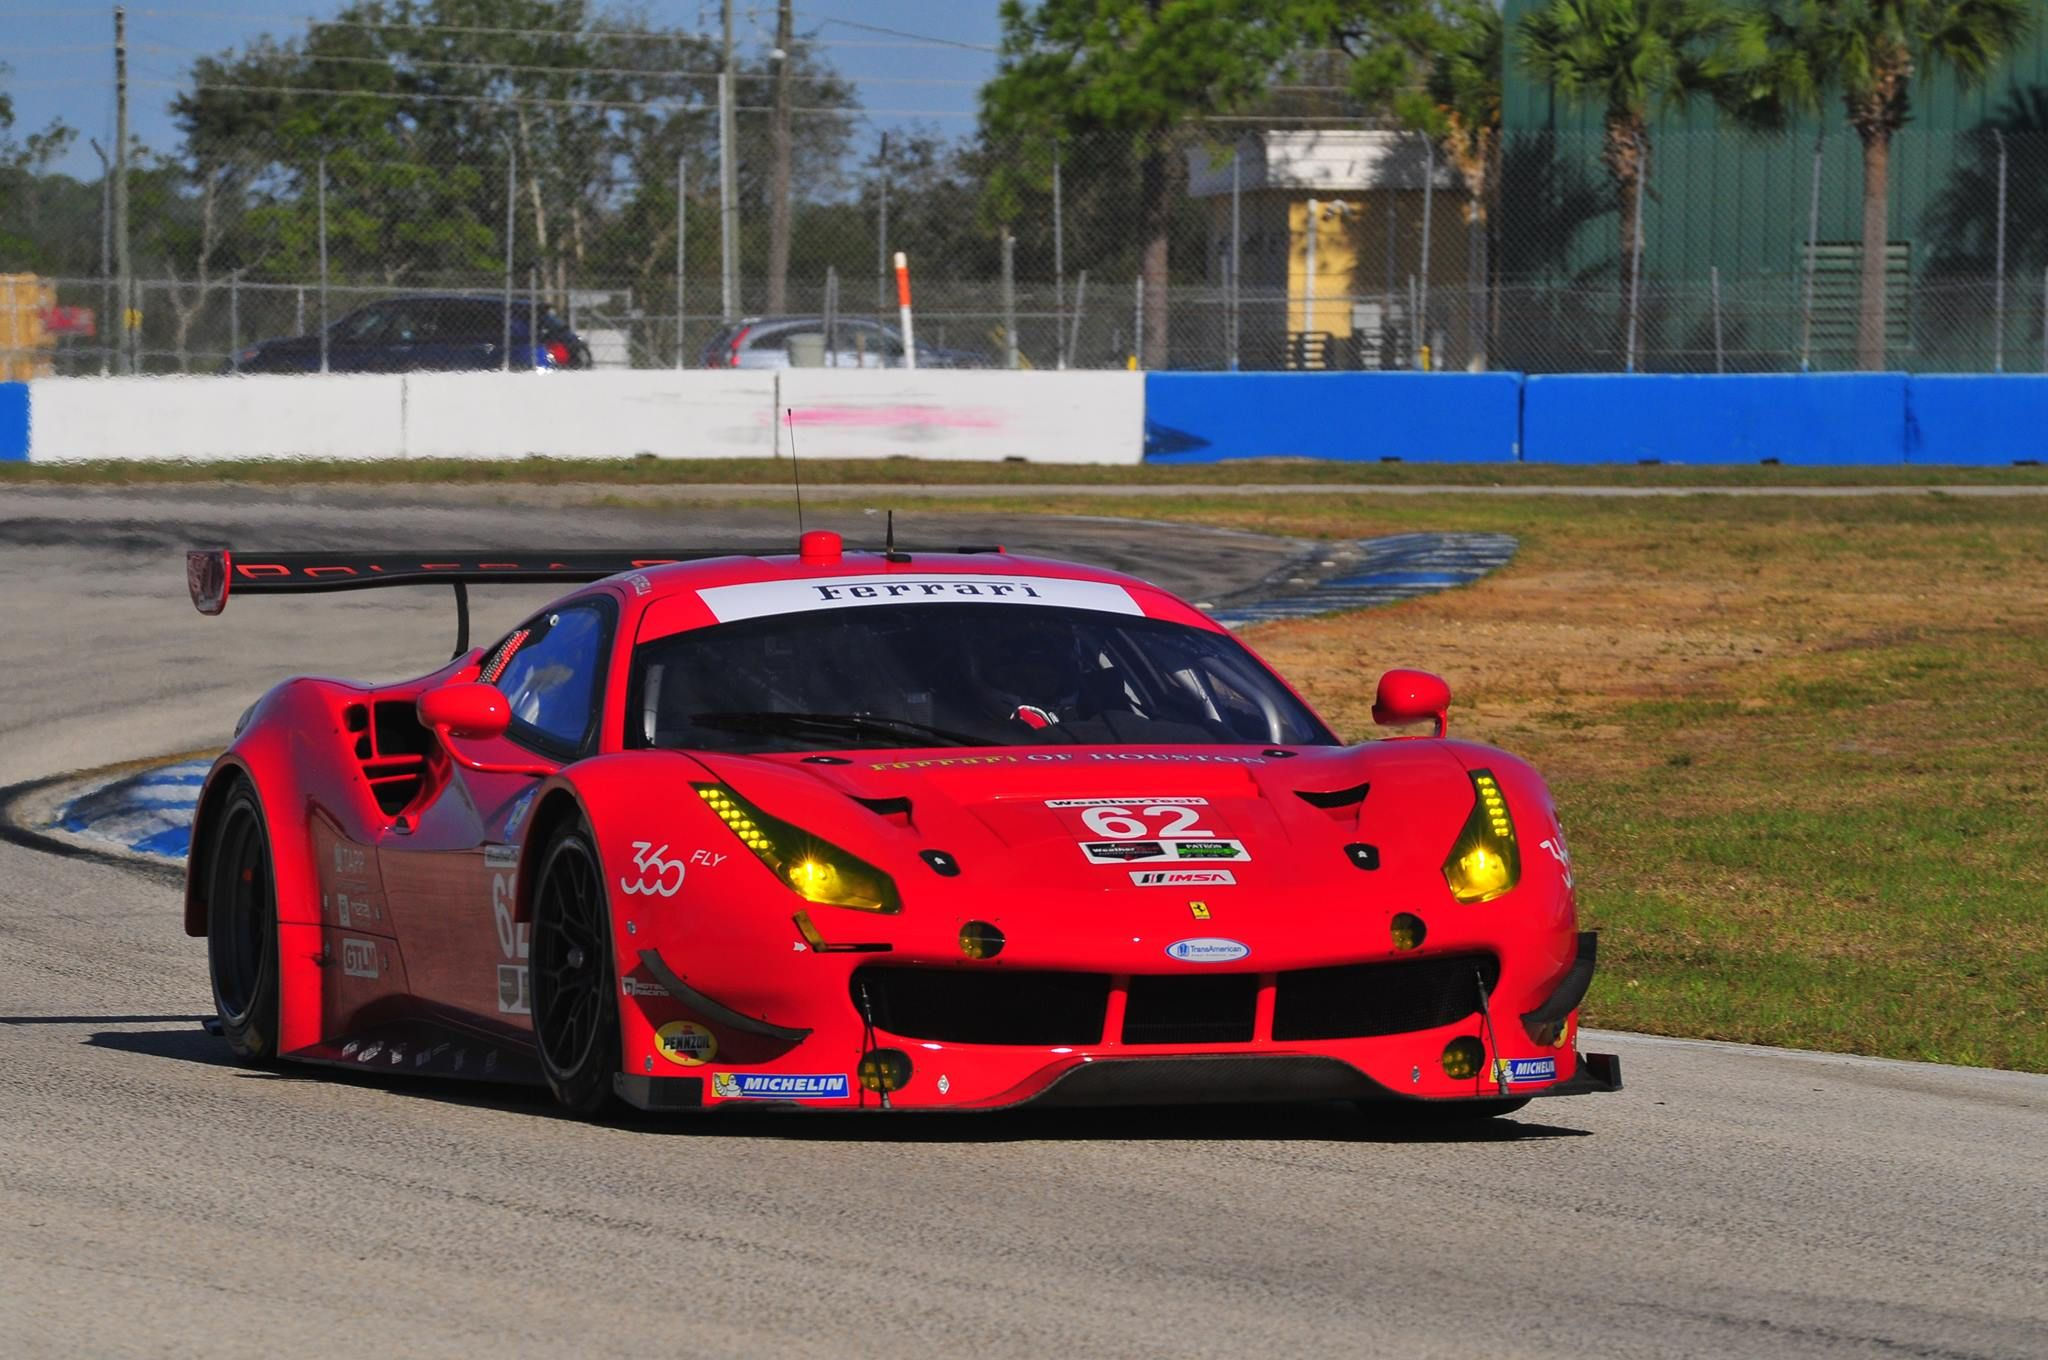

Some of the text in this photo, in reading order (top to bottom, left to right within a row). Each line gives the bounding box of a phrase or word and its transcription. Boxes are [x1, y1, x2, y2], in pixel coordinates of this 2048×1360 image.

[813, 581, 1041, 600] Ferrari
[1026, 753, 1073, 761] OF
[1089, 753, 1266, 765] HOUSTON
[1052, 798, 1202, 806] WeatherTech
[1081, 806, 1216, 839] 62
[621, 841, 727, 897] 360 FLY
[1168, 874, 1227, 882] IMSA
[1191, 945, 1242, 953] TransAmerican
[663, 1035, 711, 1050] PENNZOIL
[1514, 1060, 1555, 1074] MICHELIN
[743, 1077, 845, 1092] MICHELIN
